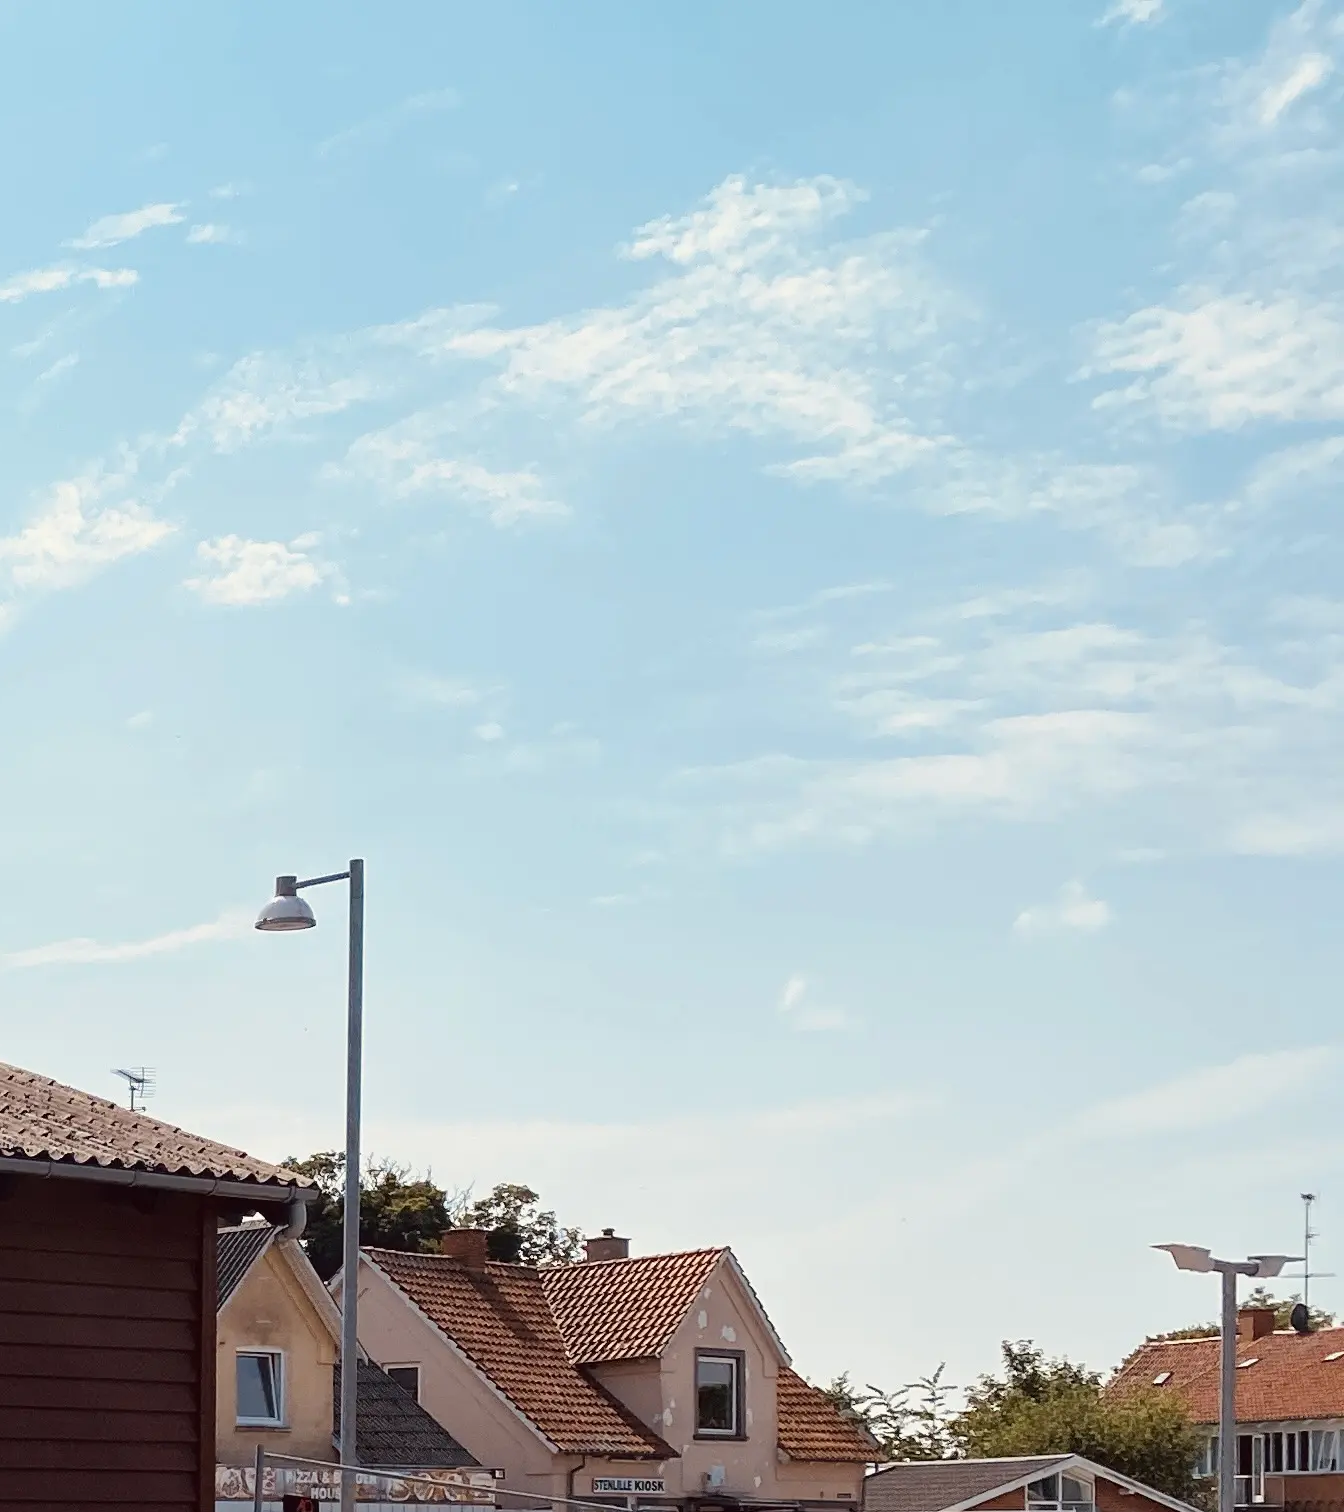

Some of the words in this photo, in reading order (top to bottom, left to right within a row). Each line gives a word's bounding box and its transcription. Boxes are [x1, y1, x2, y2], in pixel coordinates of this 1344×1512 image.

[286, 1470, 318, 1484] PIZZA
[322, 1472, 331, 1484] &
[333, 1471, 376, 1484] BGER
[594, 1480, 632, 1490] STENLILLE
[635, 1481, 664, 1491] KIOSK
[311, 1487, 341, 1499] HOUS
